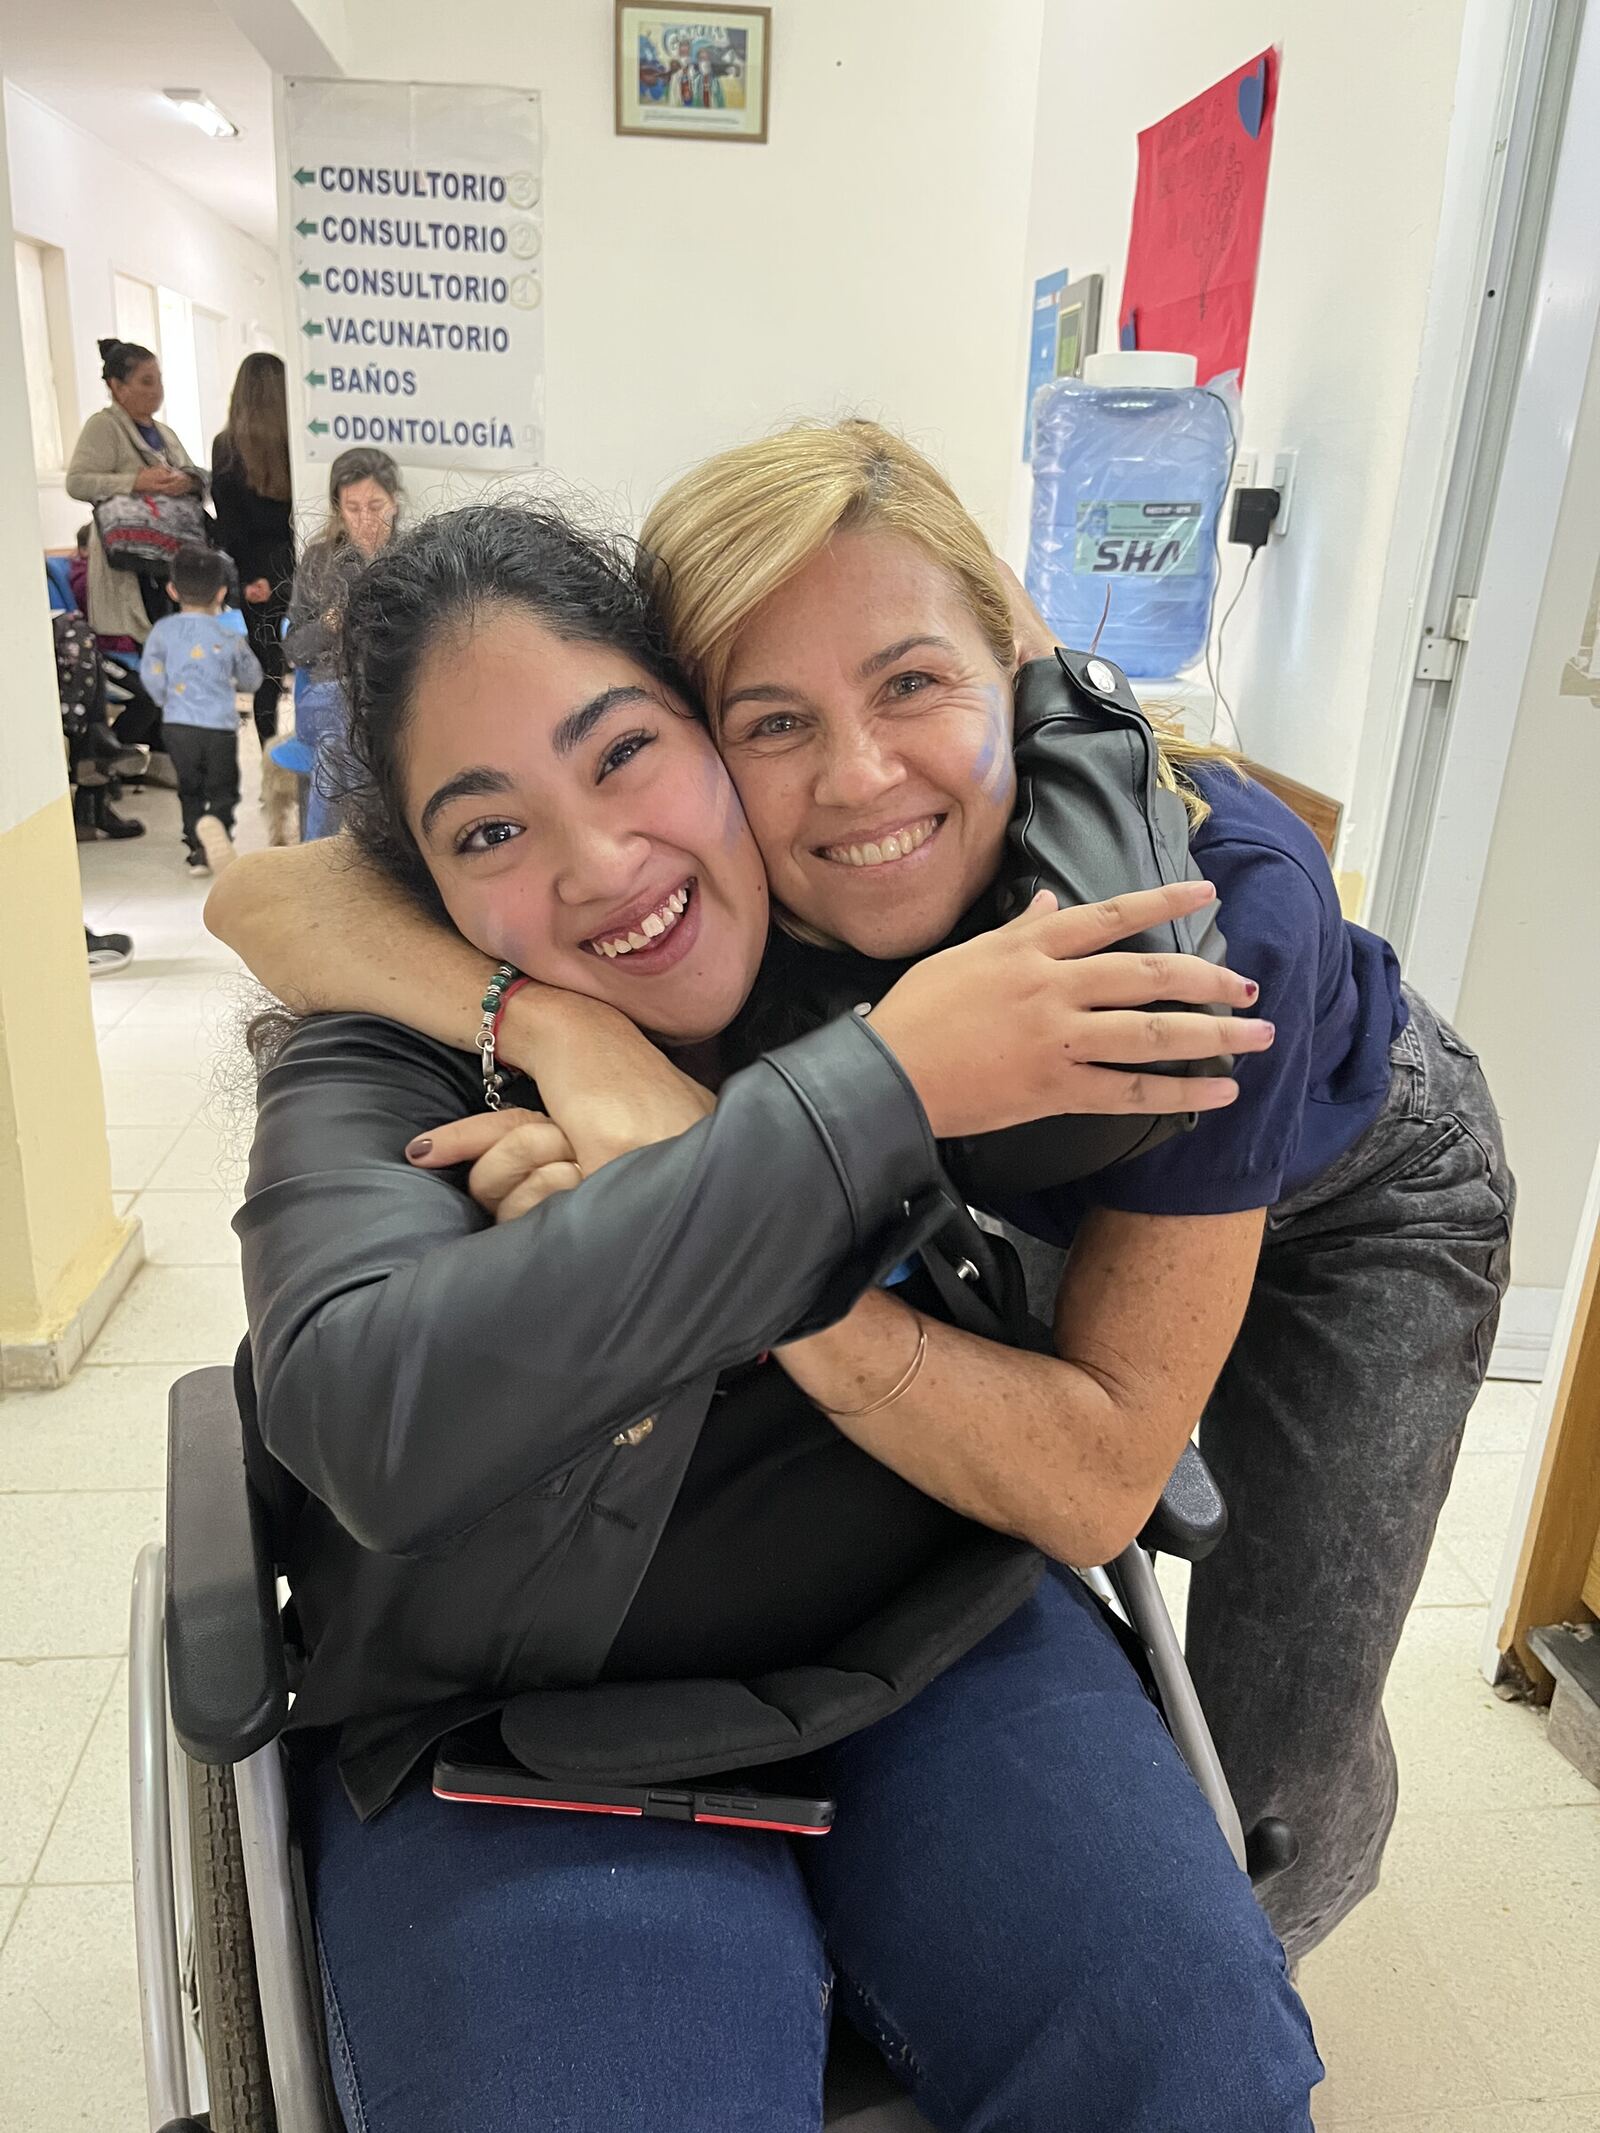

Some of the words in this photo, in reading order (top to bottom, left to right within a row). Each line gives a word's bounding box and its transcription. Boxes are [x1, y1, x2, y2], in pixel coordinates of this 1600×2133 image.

[320, 166, 506, 202] CONSULTORIO
[322, 216, 506, 252] CONSULTORIO
[325, 267, 507, 303] CONSULTORIO
[327, 317, 508, 352] VACUNATORIO
[331, 363, 416, 395] BAÑOS
[333, 415, 513, 447] ODONTOLOGÍA
